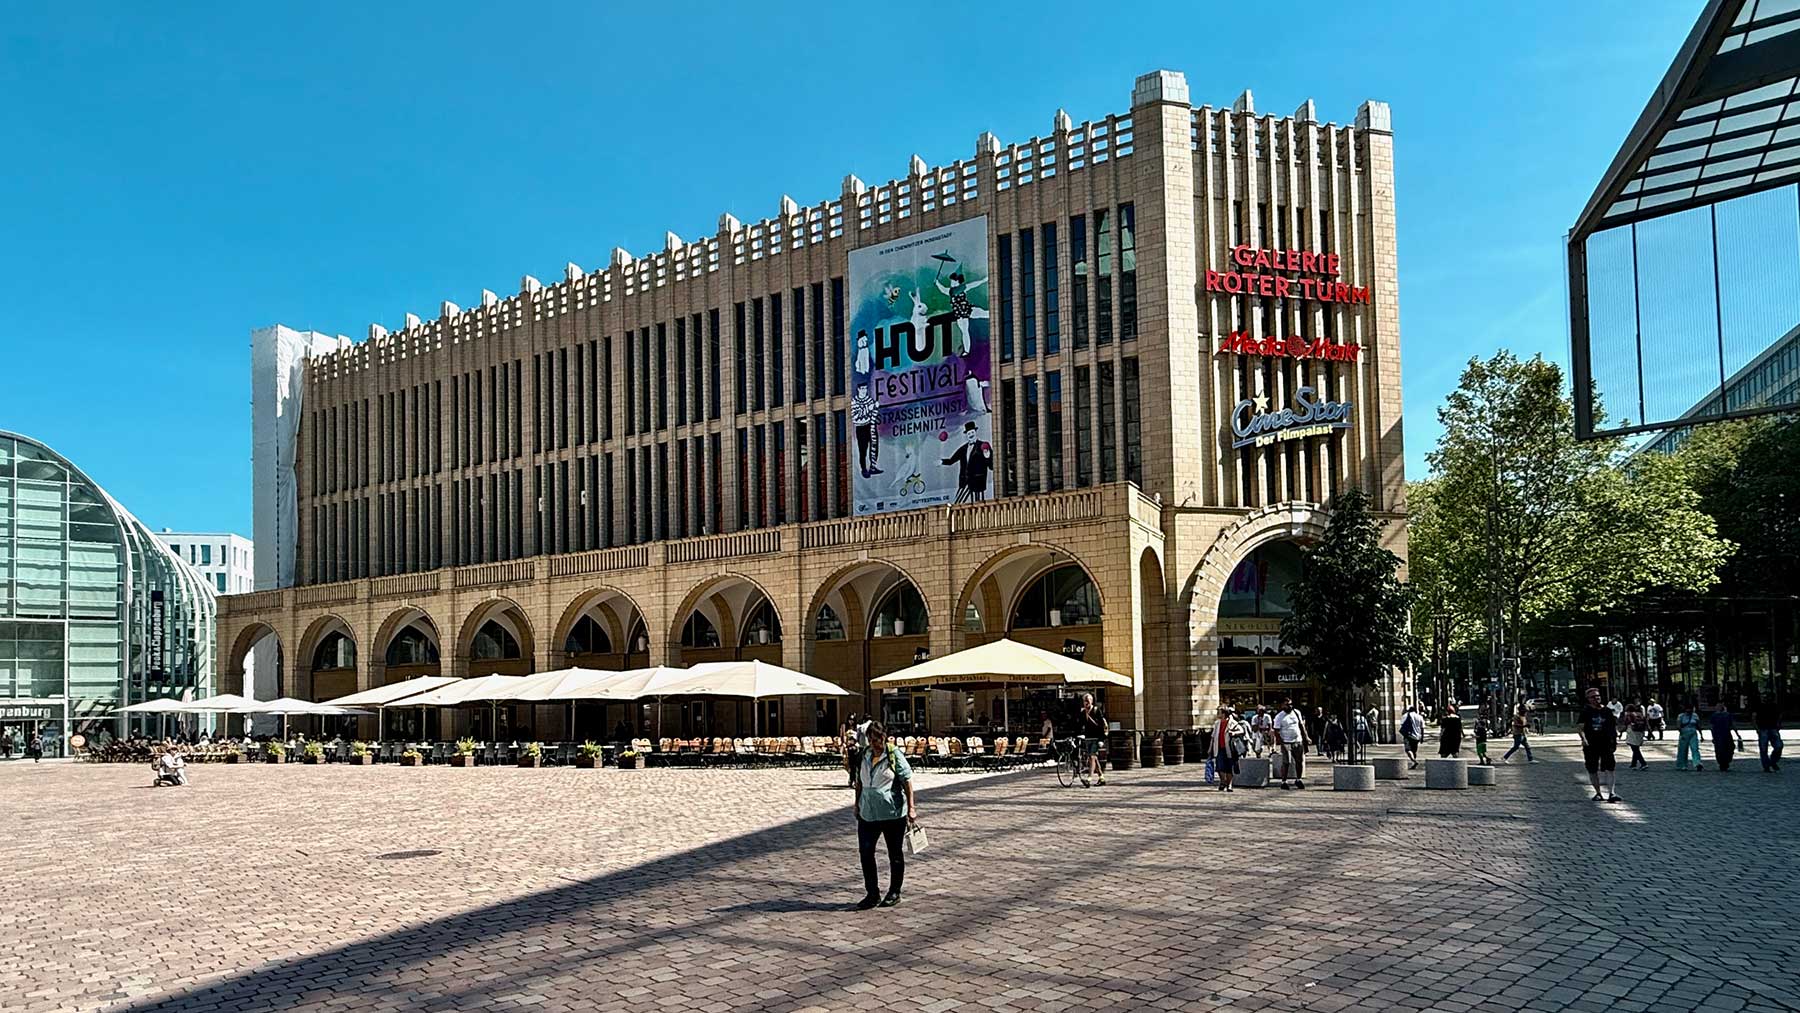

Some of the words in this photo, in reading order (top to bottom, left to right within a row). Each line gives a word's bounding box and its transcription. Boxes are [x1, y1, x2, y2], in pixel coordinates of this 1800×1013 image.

[1234, 244, 1340, 276] GALERIE
[1205, 268, 1289, 298] ROTER
[1300, 278, 1371, 304] TURM
[874, 311, 957, 371] HUT
[1218, 329, 1286, 357] Media
[1302, 337, 1362, 362] Markt
[892, 416, 946, 437] CHEMNITZ
[1232, 386, 1353, 438] CineStar
[1255, 435, 1275, 448] Der
[1277, 424, 1334, 443] Filmpalast
